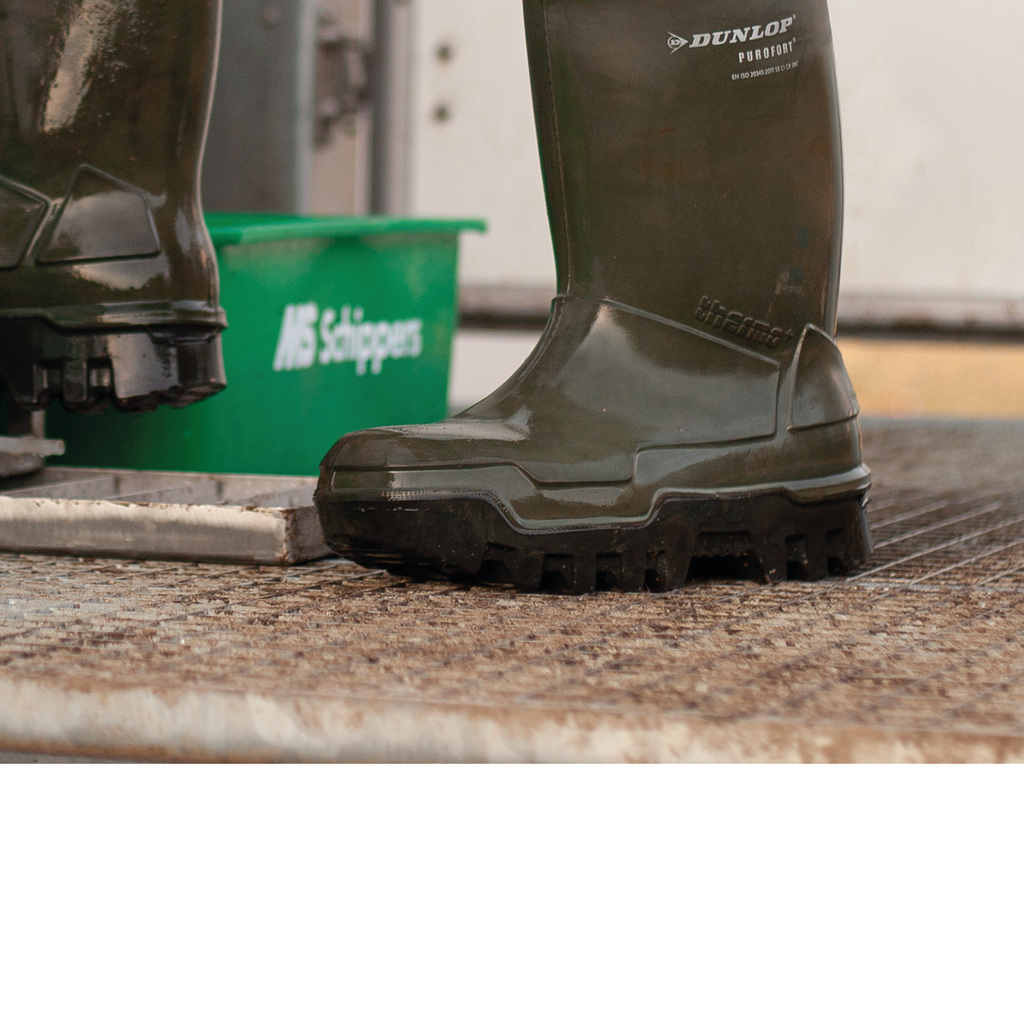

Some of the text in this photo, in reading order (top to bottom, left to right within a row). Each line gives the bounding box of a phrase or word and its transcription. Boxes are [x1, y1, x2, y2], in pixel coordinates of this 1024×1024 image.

[689, 17, 793, 48] DUNLOP
[738, 41, 794, 63] PUROFORT
[273, 301, 422, 376] MS Schippers
